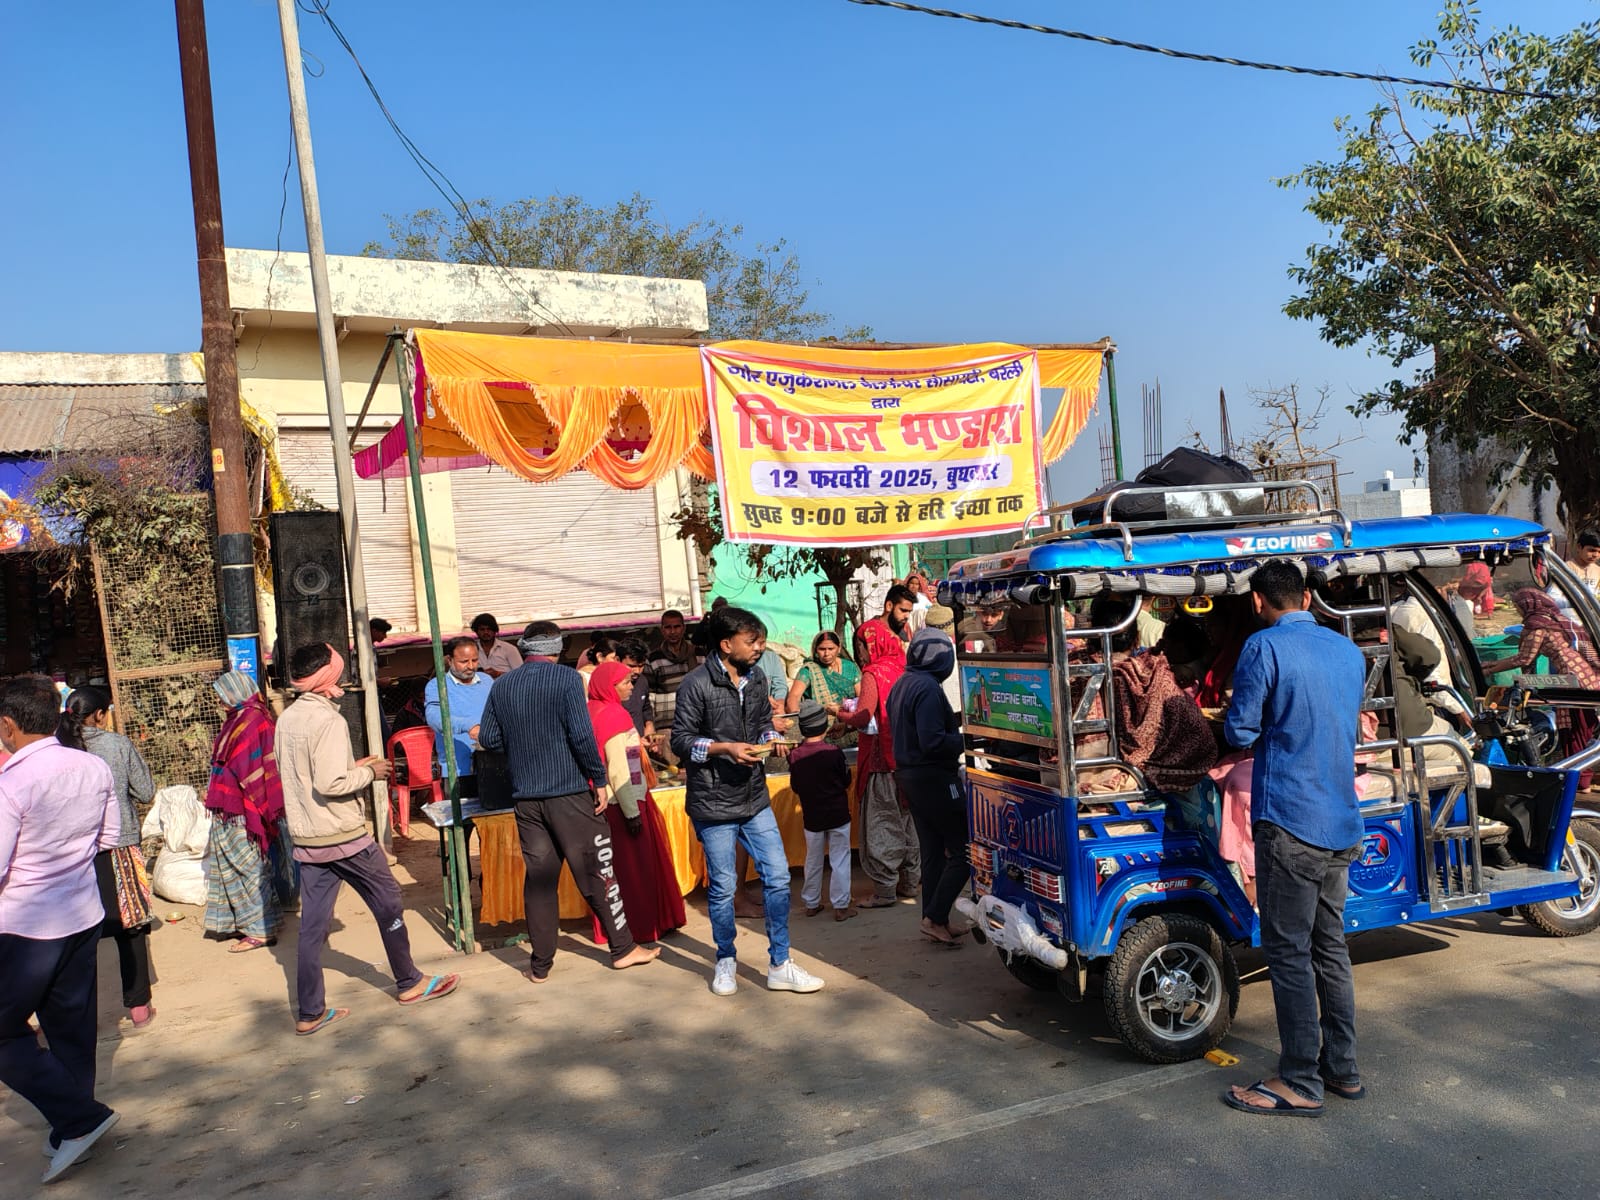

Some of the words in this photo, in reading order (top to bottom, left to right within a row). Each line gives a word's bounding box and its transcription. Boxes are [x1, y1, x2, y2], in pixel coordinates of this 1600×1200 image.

[871, 397, 901, 409] द्वारा
[732, 393, 884, 452] विशाल
[769, 469, 798, 488] 12
[808, 465, 872, 489] फरवरी
[880, 468, 938, 489] 2025,
[741, 503, 783, 528] सुबह
[791, 507, 846, 525] 9:00
[855, 501, 889, 524] बजे
[895, 500, 912, 522] से
[918, 498, 945, 520] हरि
[951, 498, 991, 520] इच्छा
[996, 495, 1024, 513] तक
[1240, 535, 1319, 552] ZEOFINE
[991, 691, 1020, 705] ZEOFINE
[1150, 880, 1188, 890] ZEOFINE
